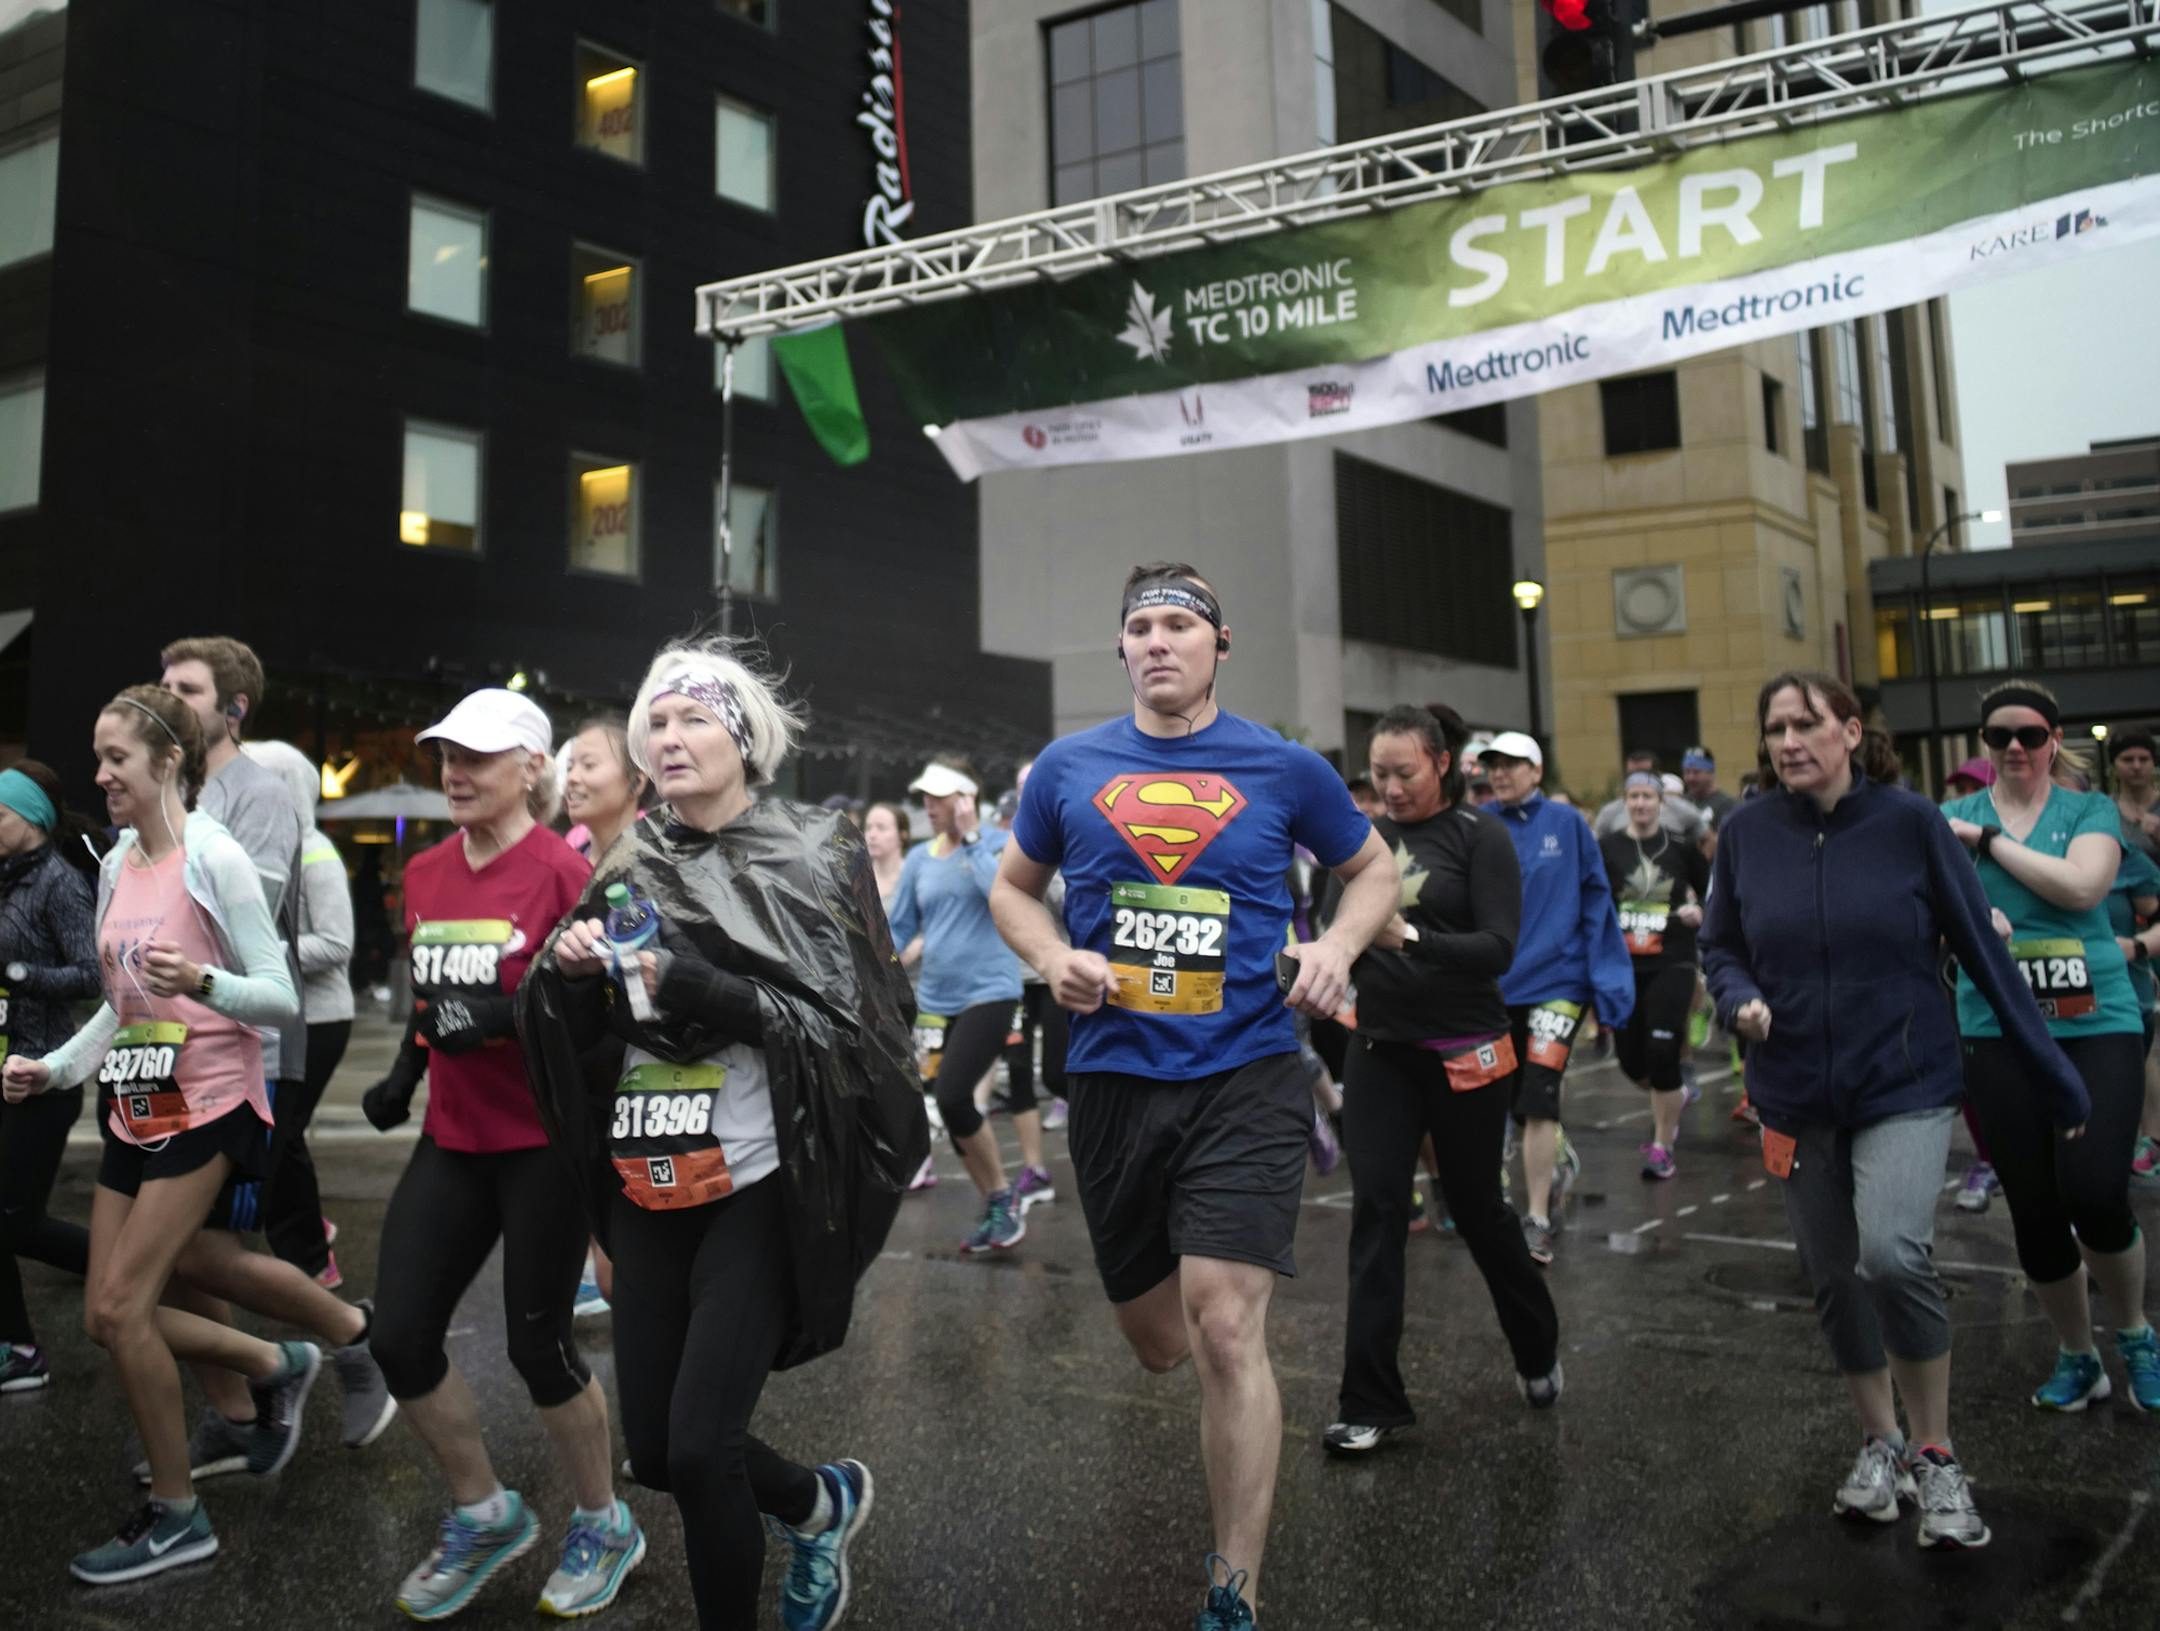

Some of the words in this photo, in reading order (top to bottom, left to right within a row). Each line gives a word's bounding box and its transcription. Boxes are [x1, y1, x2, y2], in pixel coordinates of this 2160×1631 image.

[2014, 129, 2063, 150] The
[1447, 142, 1858, 308] START
[1970, 224, 2050, 261] KARE
[1184, 257, 1354, 314] MEDTRONIC
[1662, 273, 1865, 341] Medtronic
[1186, 312, 1231, 346] TC
[1235, 305, 1270, 339] 10
[1276, 288, 1358, 332] MILE
[1426, 332, 1591, 395] Medtronic
[1179, 895, 1188, 904] B
[1114, 909, 1222, 957] 26232
[412, 944, 499, 985] 31408
[1153, 952, 1175, 968] Joe
[99, 1046, 175, 1083] 33760
[611, 1093, 712, 1139] 31396
